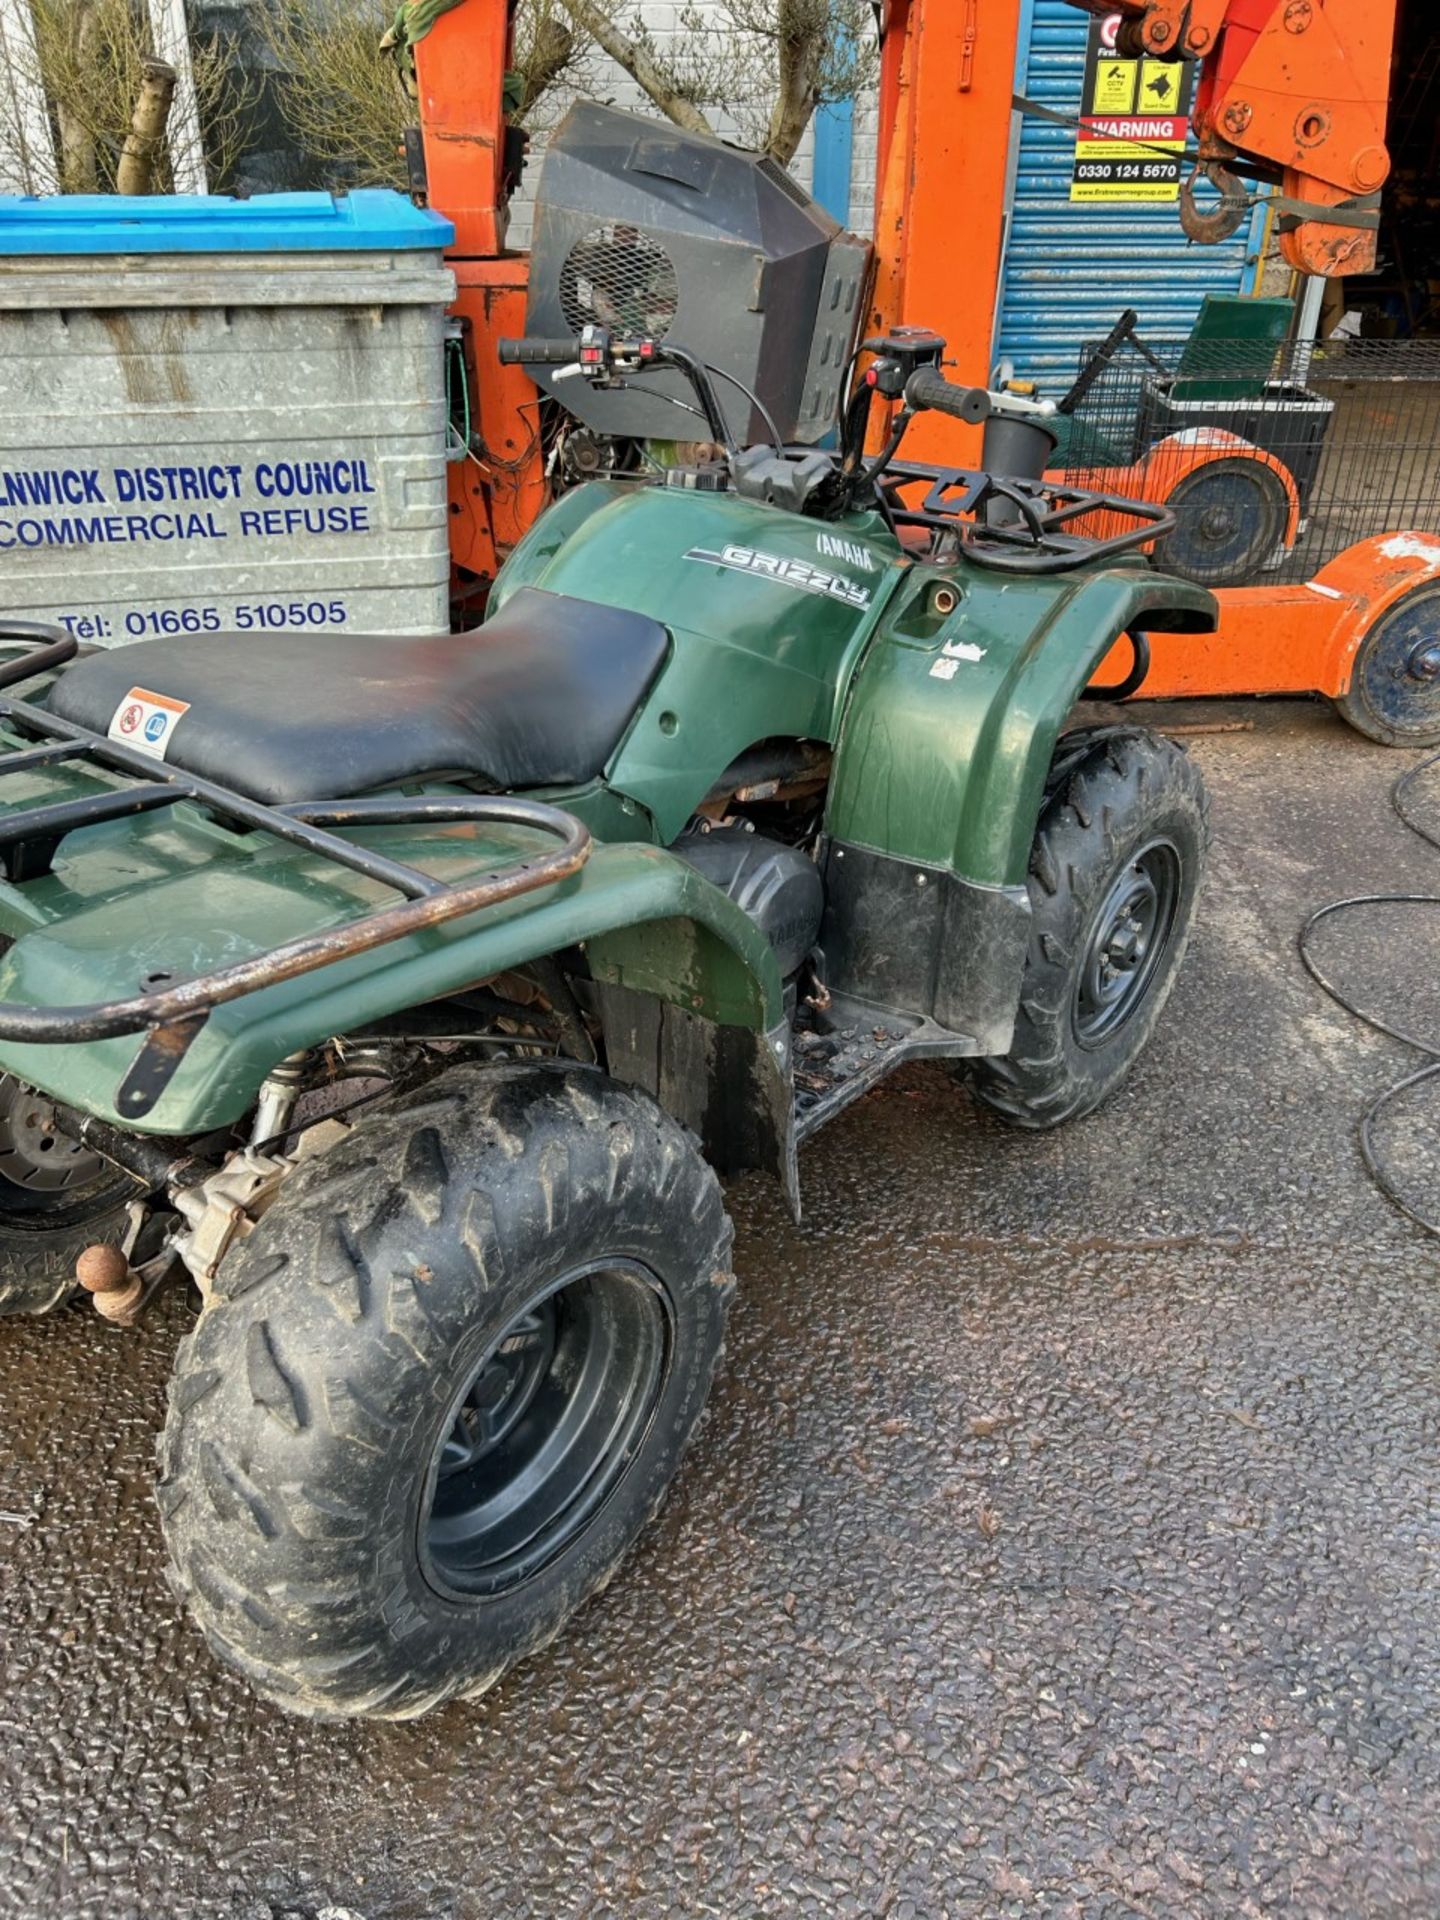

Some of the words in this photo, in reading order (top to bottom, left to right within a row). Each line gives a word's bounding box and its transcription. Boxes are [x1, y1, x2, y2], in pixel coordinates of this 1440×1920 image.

[1092, 121, 1174, 138] WARNING
[1078, 165, 1111, 178] 0330
[1116, 165, 1139, 178] 124
[1143, 165, 1177, 178] 5670
[114, 465, 242, 501] DISTRICT
[255, 460, 375, 497] COUNCIL
[0, 513, 227, 548] COMMERCIAL
[241, 506, 370, 536] REFUSE
[721, 544, 871, 604] GRIZZLY
[58, 614, 112, 638] Tel:
[125, 607, 221, 636] 01665
[235, 602, 346, 630] 510505
